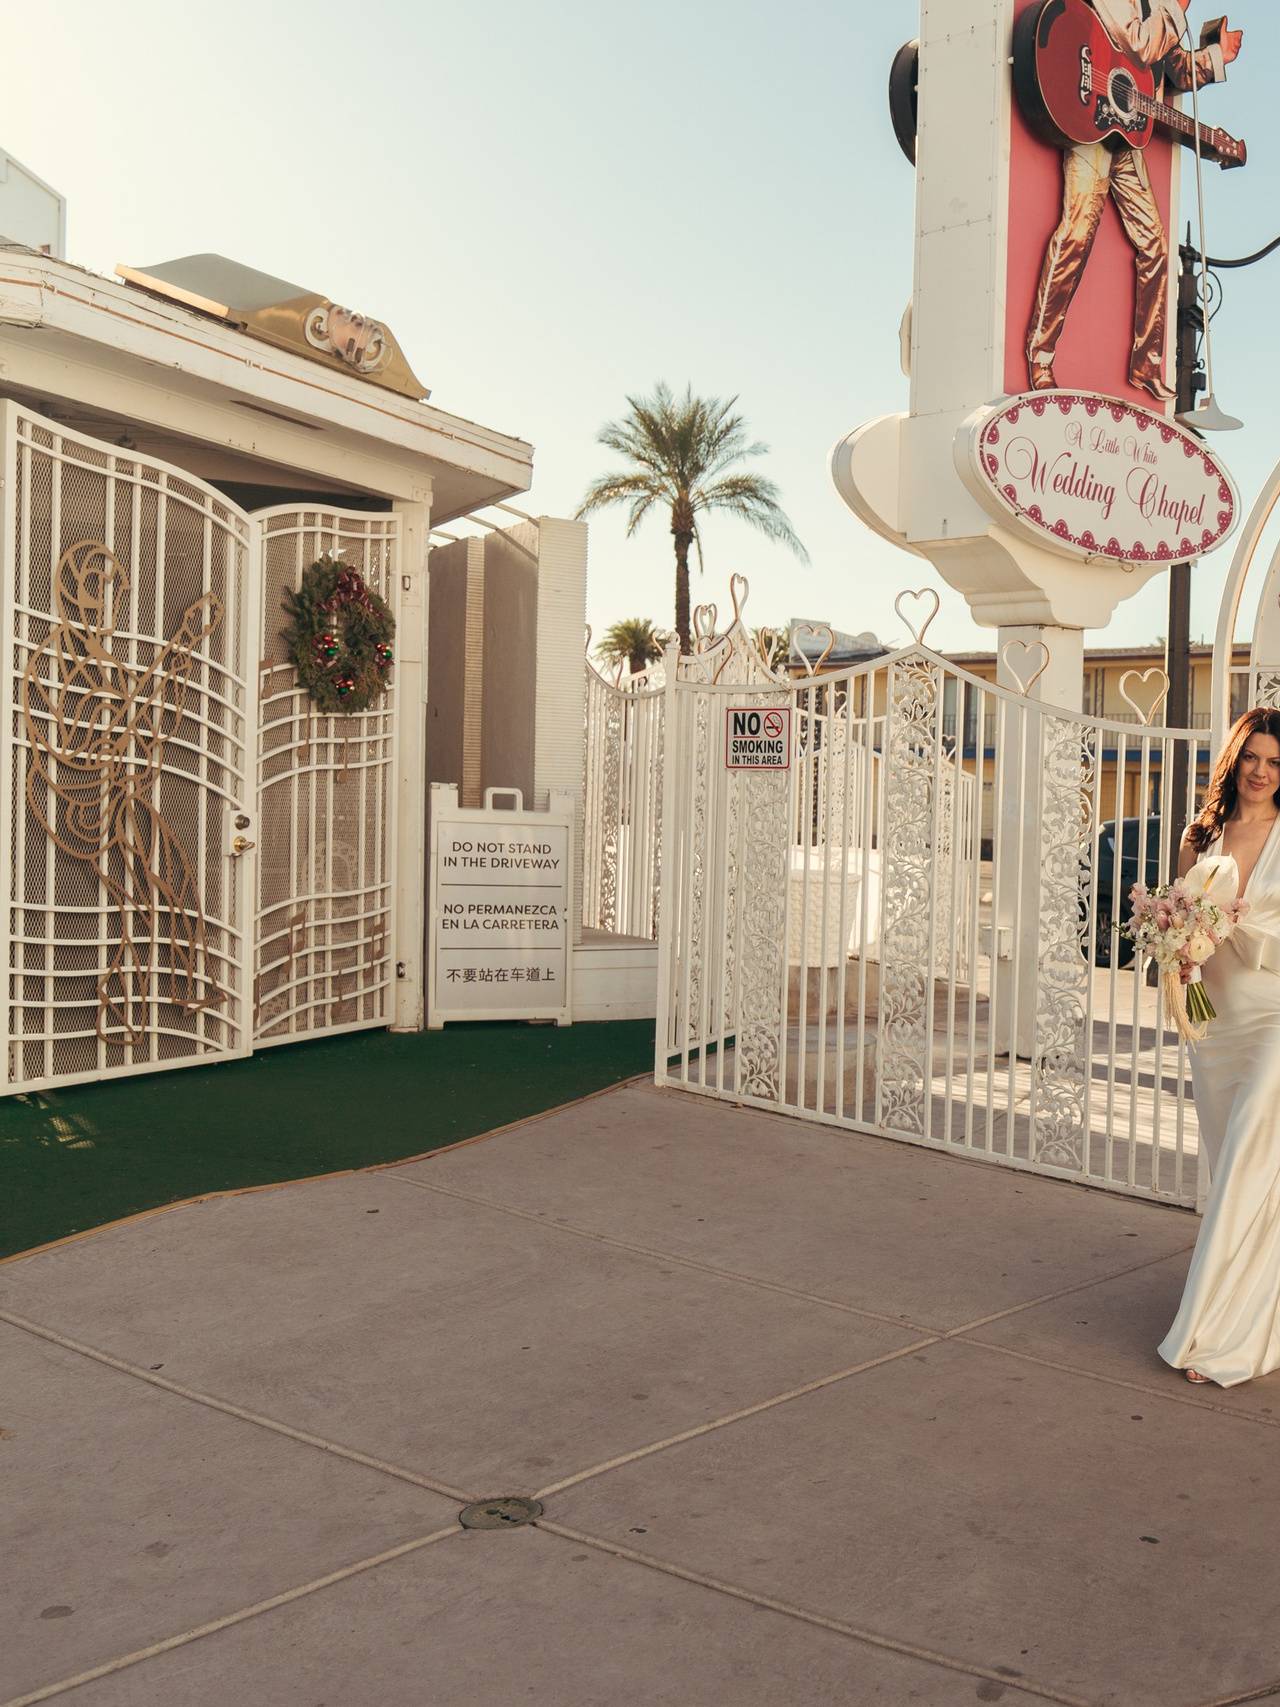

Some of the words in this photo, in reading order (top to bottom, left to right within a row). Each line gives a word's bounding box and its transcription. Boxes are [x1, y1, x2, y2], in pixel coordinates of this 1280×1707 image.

[1064, 420, 1084, 450] A
[1089, 426, 1120, 456] Little
[1123, 435, 1158, 466] White
[1004, 436, 1116, 520] Wedding
[1125, 466, 1206, 535] Chapel
[733, 712, 761, 735] NO
[732, 740, 783, 753] SMOKING
[732, 755, 740, 765] IN
[742, 755, 760, 765] THIS
[761, 755, 782, 765] AREA
[452, 841, 473, 852] DO
[477, 842, 505, 853] NOT
[508, 843, 552, 855] STAND
[443, 856, 457, 867] IN
[461, 856, 487, 868] THE
[491, 857, 560, 869] DRIVEWAY
[443, 904, 464, 915] NO
[468, 904, 558, 915] PERMANEZCA
[442, 919, 459, 930] EN
[463, 919, 480, 930] LA
[482, 919, 559, 930] CARRETERA
[446, 967, 556, 983] 不要站在车道上
